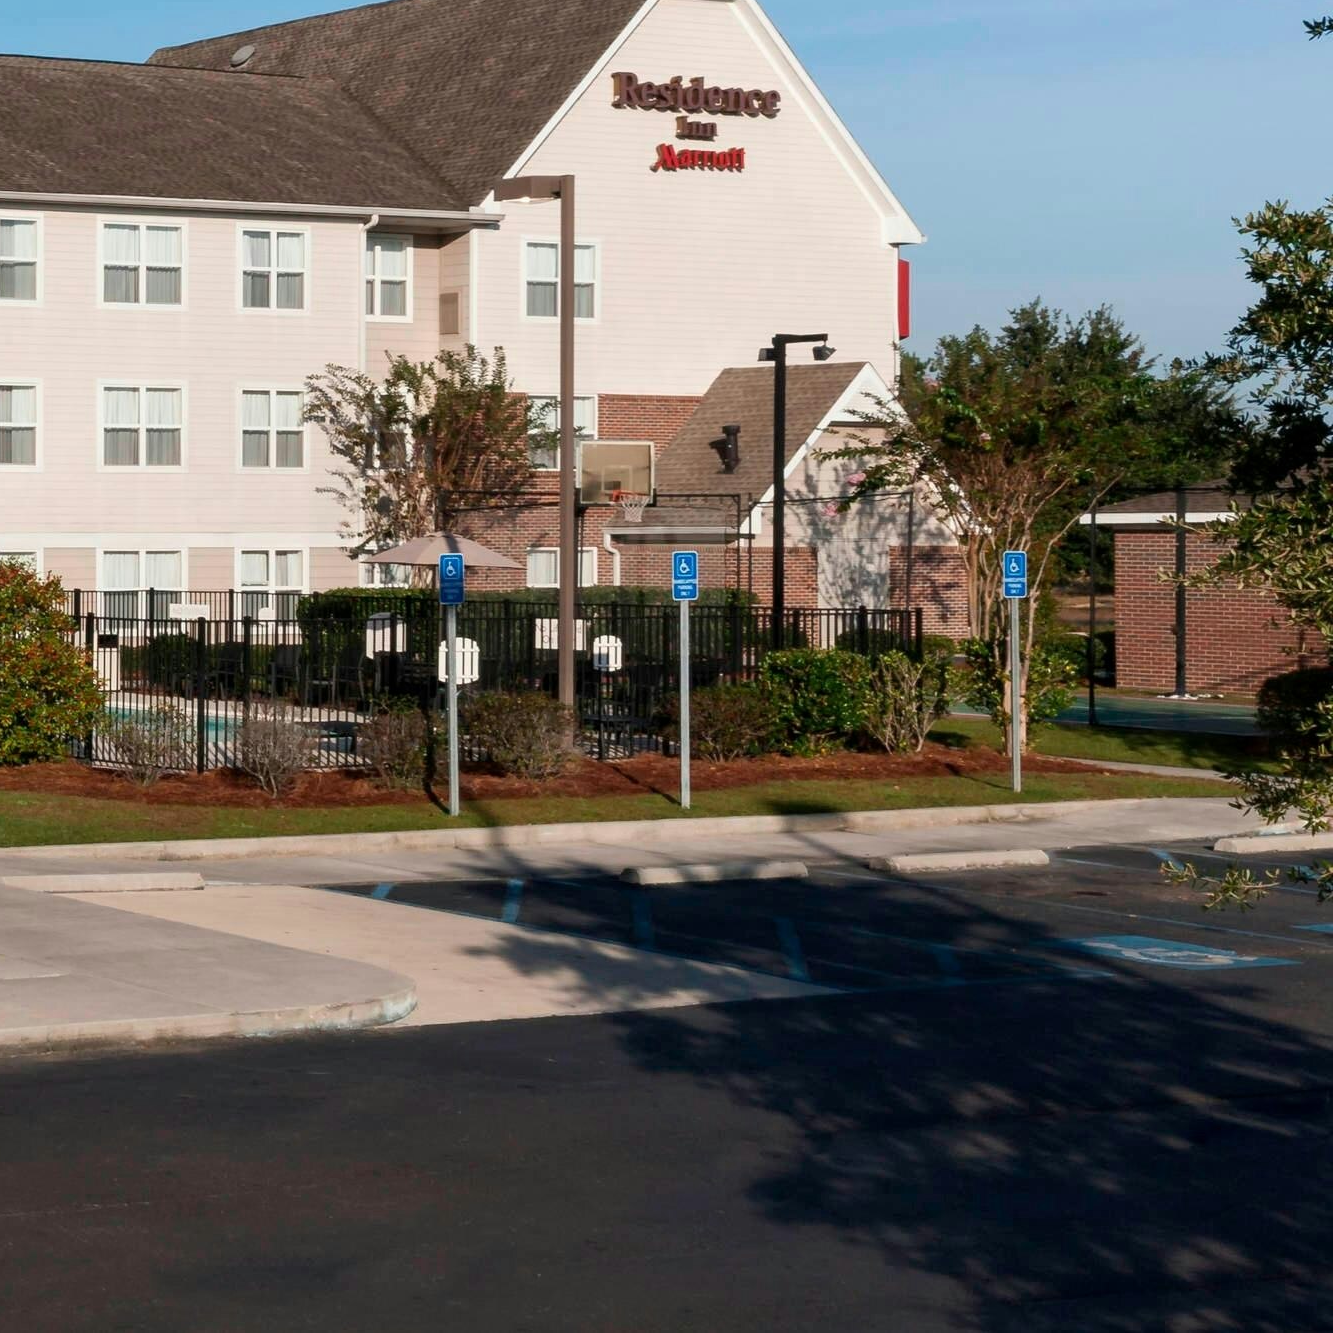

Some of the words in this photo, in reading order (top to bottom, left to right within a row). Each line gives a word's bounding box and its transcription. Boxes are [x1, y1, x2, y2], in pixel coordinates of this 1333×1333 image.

[611, 72, 781, 118] Residence
[676, 116, 718, 141] Inn
[650, 143, 745, 172] Marriott
